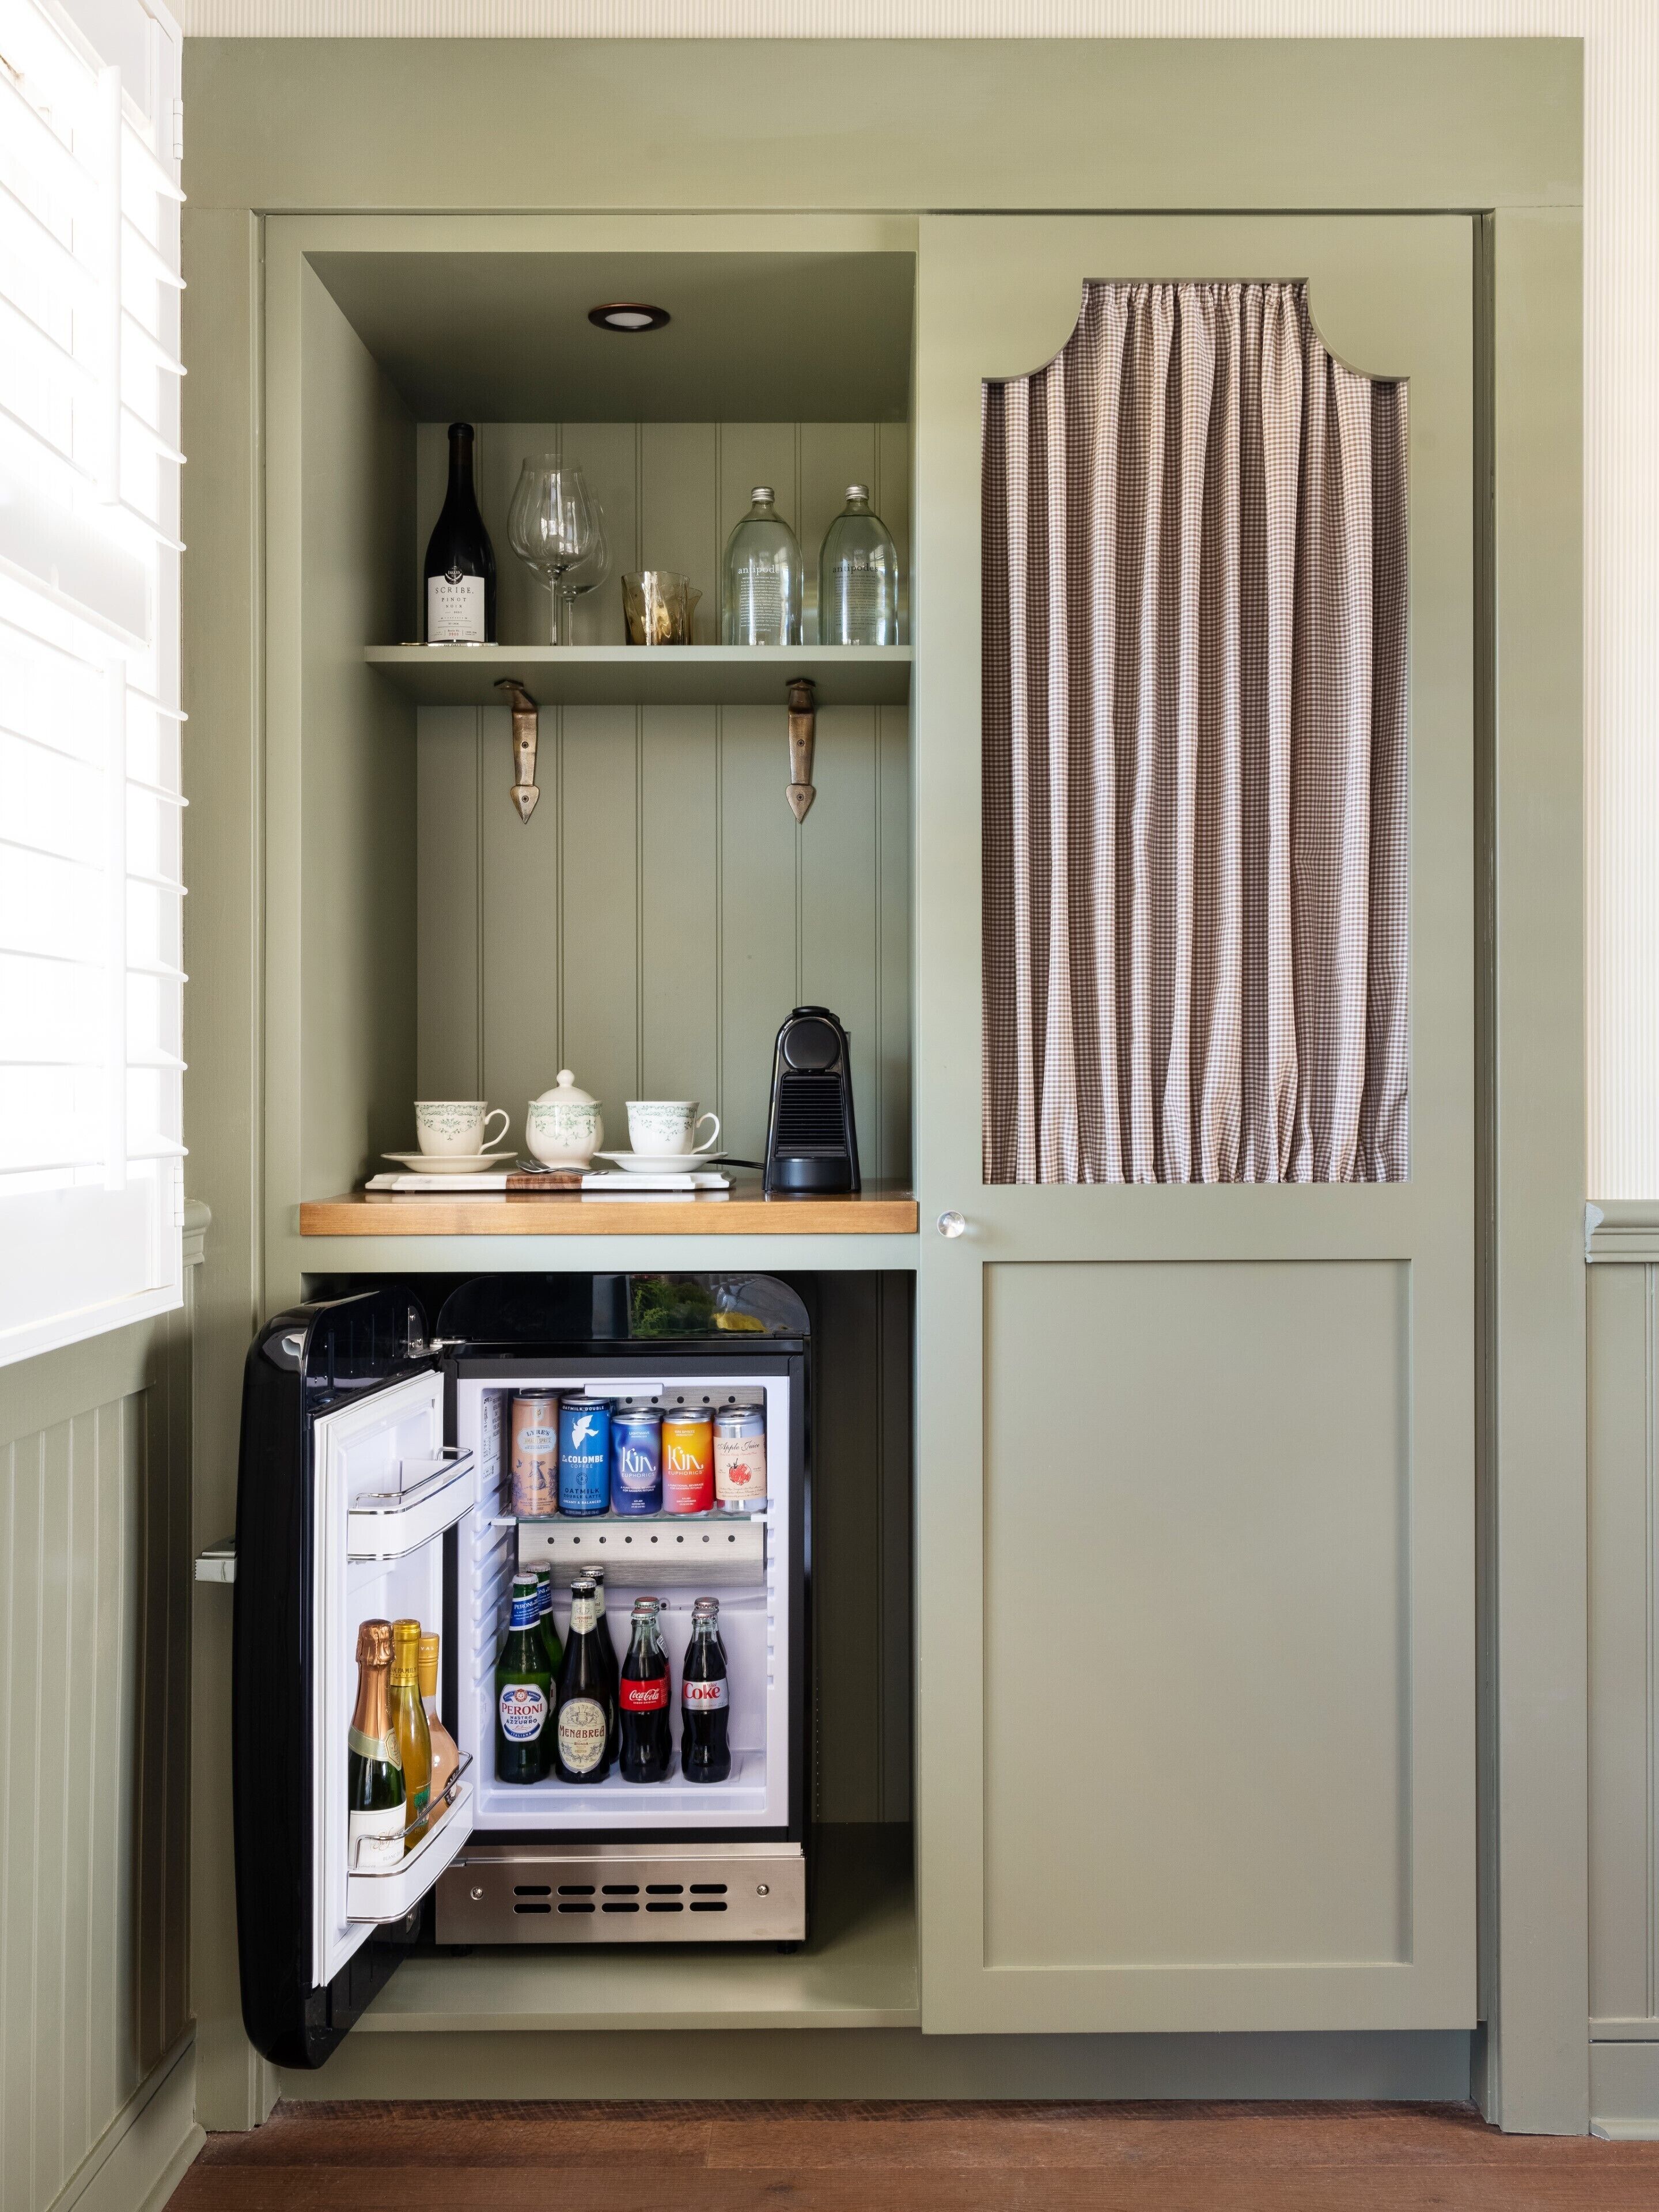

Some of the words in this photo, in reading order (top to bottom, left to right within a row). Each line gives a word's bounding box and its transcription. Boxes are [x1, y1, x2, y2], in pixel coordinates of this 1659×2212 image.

[717, 1442, 740, 1453] Apple
[741, 1440, 760, 1451] Juice
[568, 1455, 604, 1463] COLOMBE
[622, 1446, 656, 1472] Kin
[668, 1445, 704, 1471] Kin
[514, 1601, 533, 1609] PERONI
[684, 1683, 721, 1699] Coke
[502, 1702, 543, 1715] PERONI
[559, 1725, 605, 1738] MENABREA
